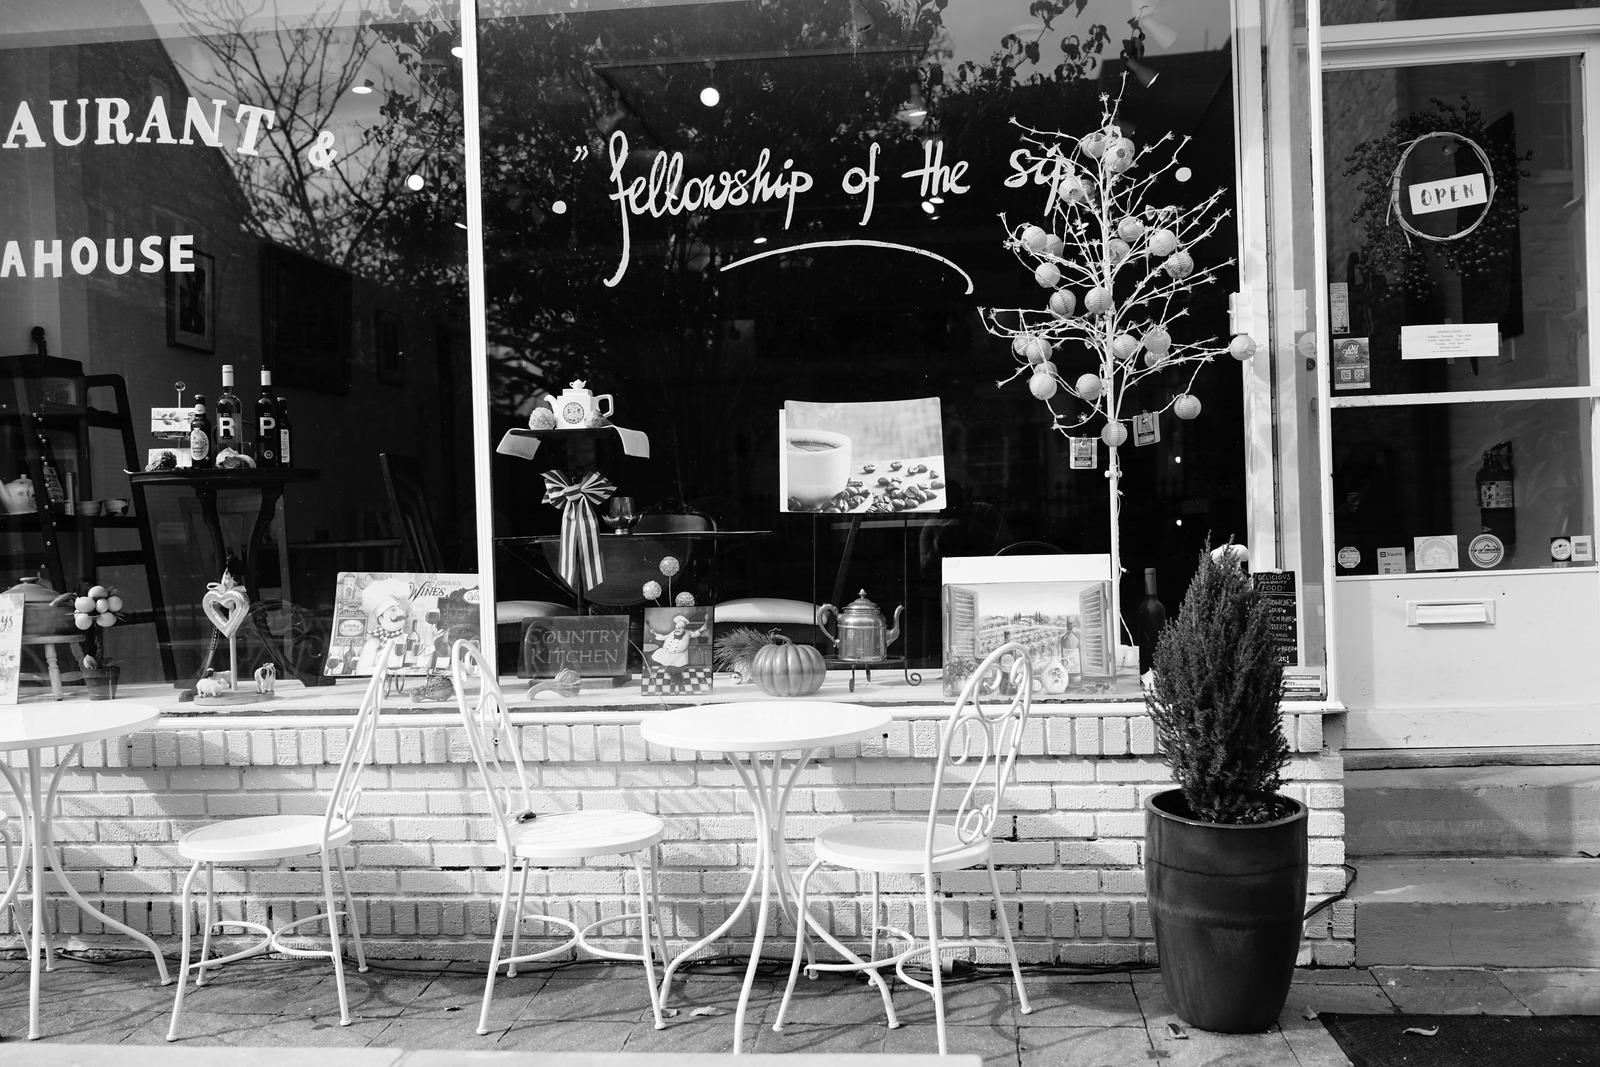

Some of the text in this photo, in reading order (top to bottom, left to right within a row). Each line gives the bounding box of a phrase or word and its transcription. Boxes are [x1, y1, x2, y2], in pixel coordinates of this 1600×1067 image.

[2, 96, 338, 171] AURANT &
[842, 142, 880, 226] of
[902, 140, 970, 197] the
[1421, 183, 1474, 206] OPEN
[0, 235, 195, 278] AHOUSE
[219, 416, 236, 437] R
[259, 416, 277, 437] P
[407, 580, 447, 602] WINES
[526, 628, 625, 645] COUNTRY
[530, 648, 618, 665] KITCHEN
